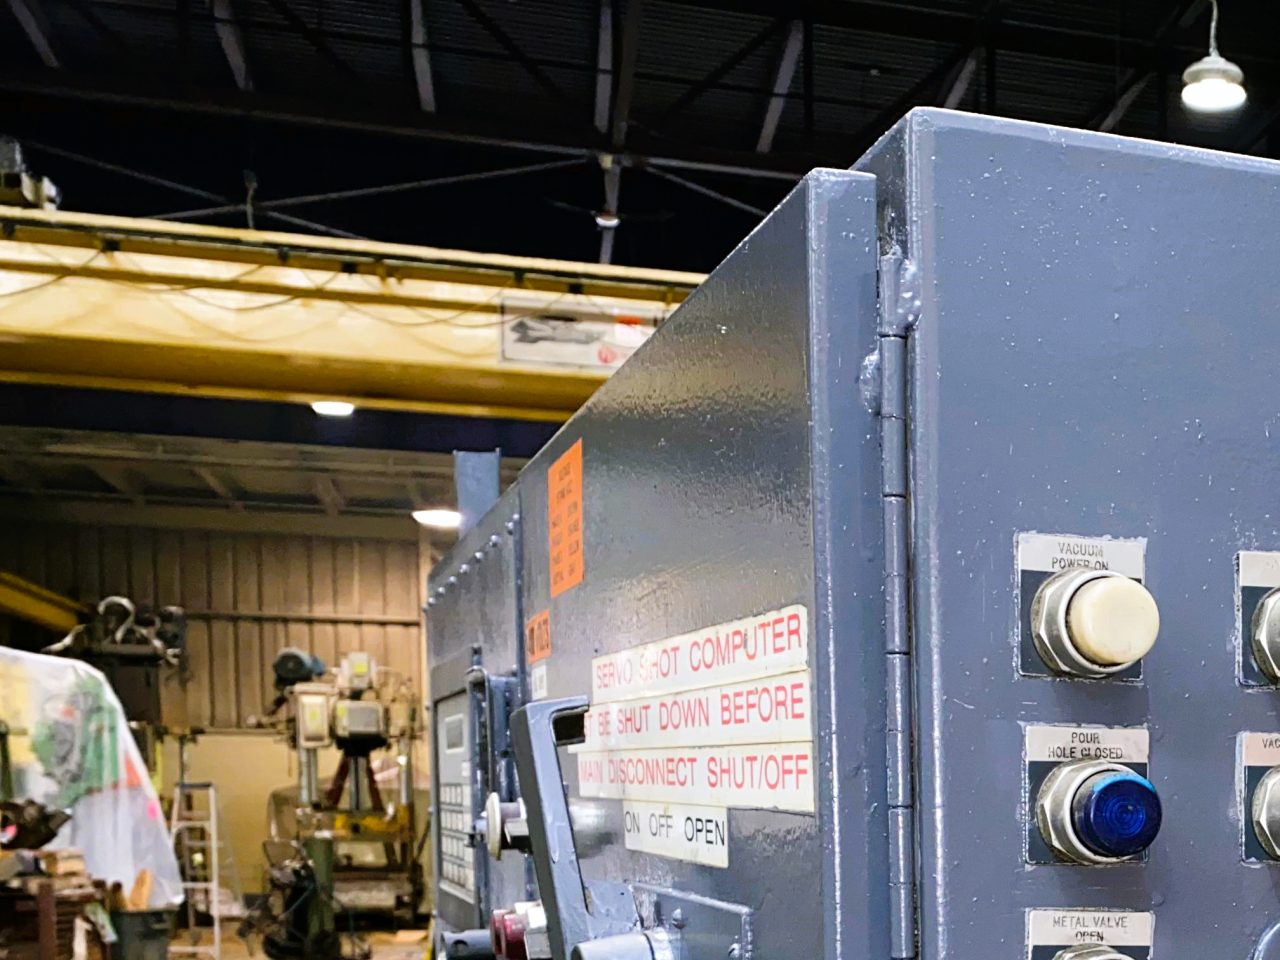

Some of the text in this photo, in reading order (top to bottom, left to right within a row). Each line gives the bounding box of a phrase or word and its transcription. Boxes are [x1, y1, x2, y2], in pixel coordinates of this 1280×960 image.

[1057, 542, 1104, 557] VACUUM
[596, 613, 802, 690] SERVO SHOT COMPUTER
[598, 711, 611, 736] BE
[617, 704, 651, 736] SHUT
[659, 697, 710, 731] DOWN
[721, 683, 805, 726] BEFORE
[1071, 732, 1101, 744] POUR
[1048, 746, 1077, 759] HOLE
[607, 757, 698, 787] DISCONNECT
[707, 754, 809, 790] SHUT/OFF
[624, 811, 725, 846] ON OFF OPEN
[1052, 916, 1128, 928] METAL VALVE
[1075, 931, 1105, 942] OPEN
